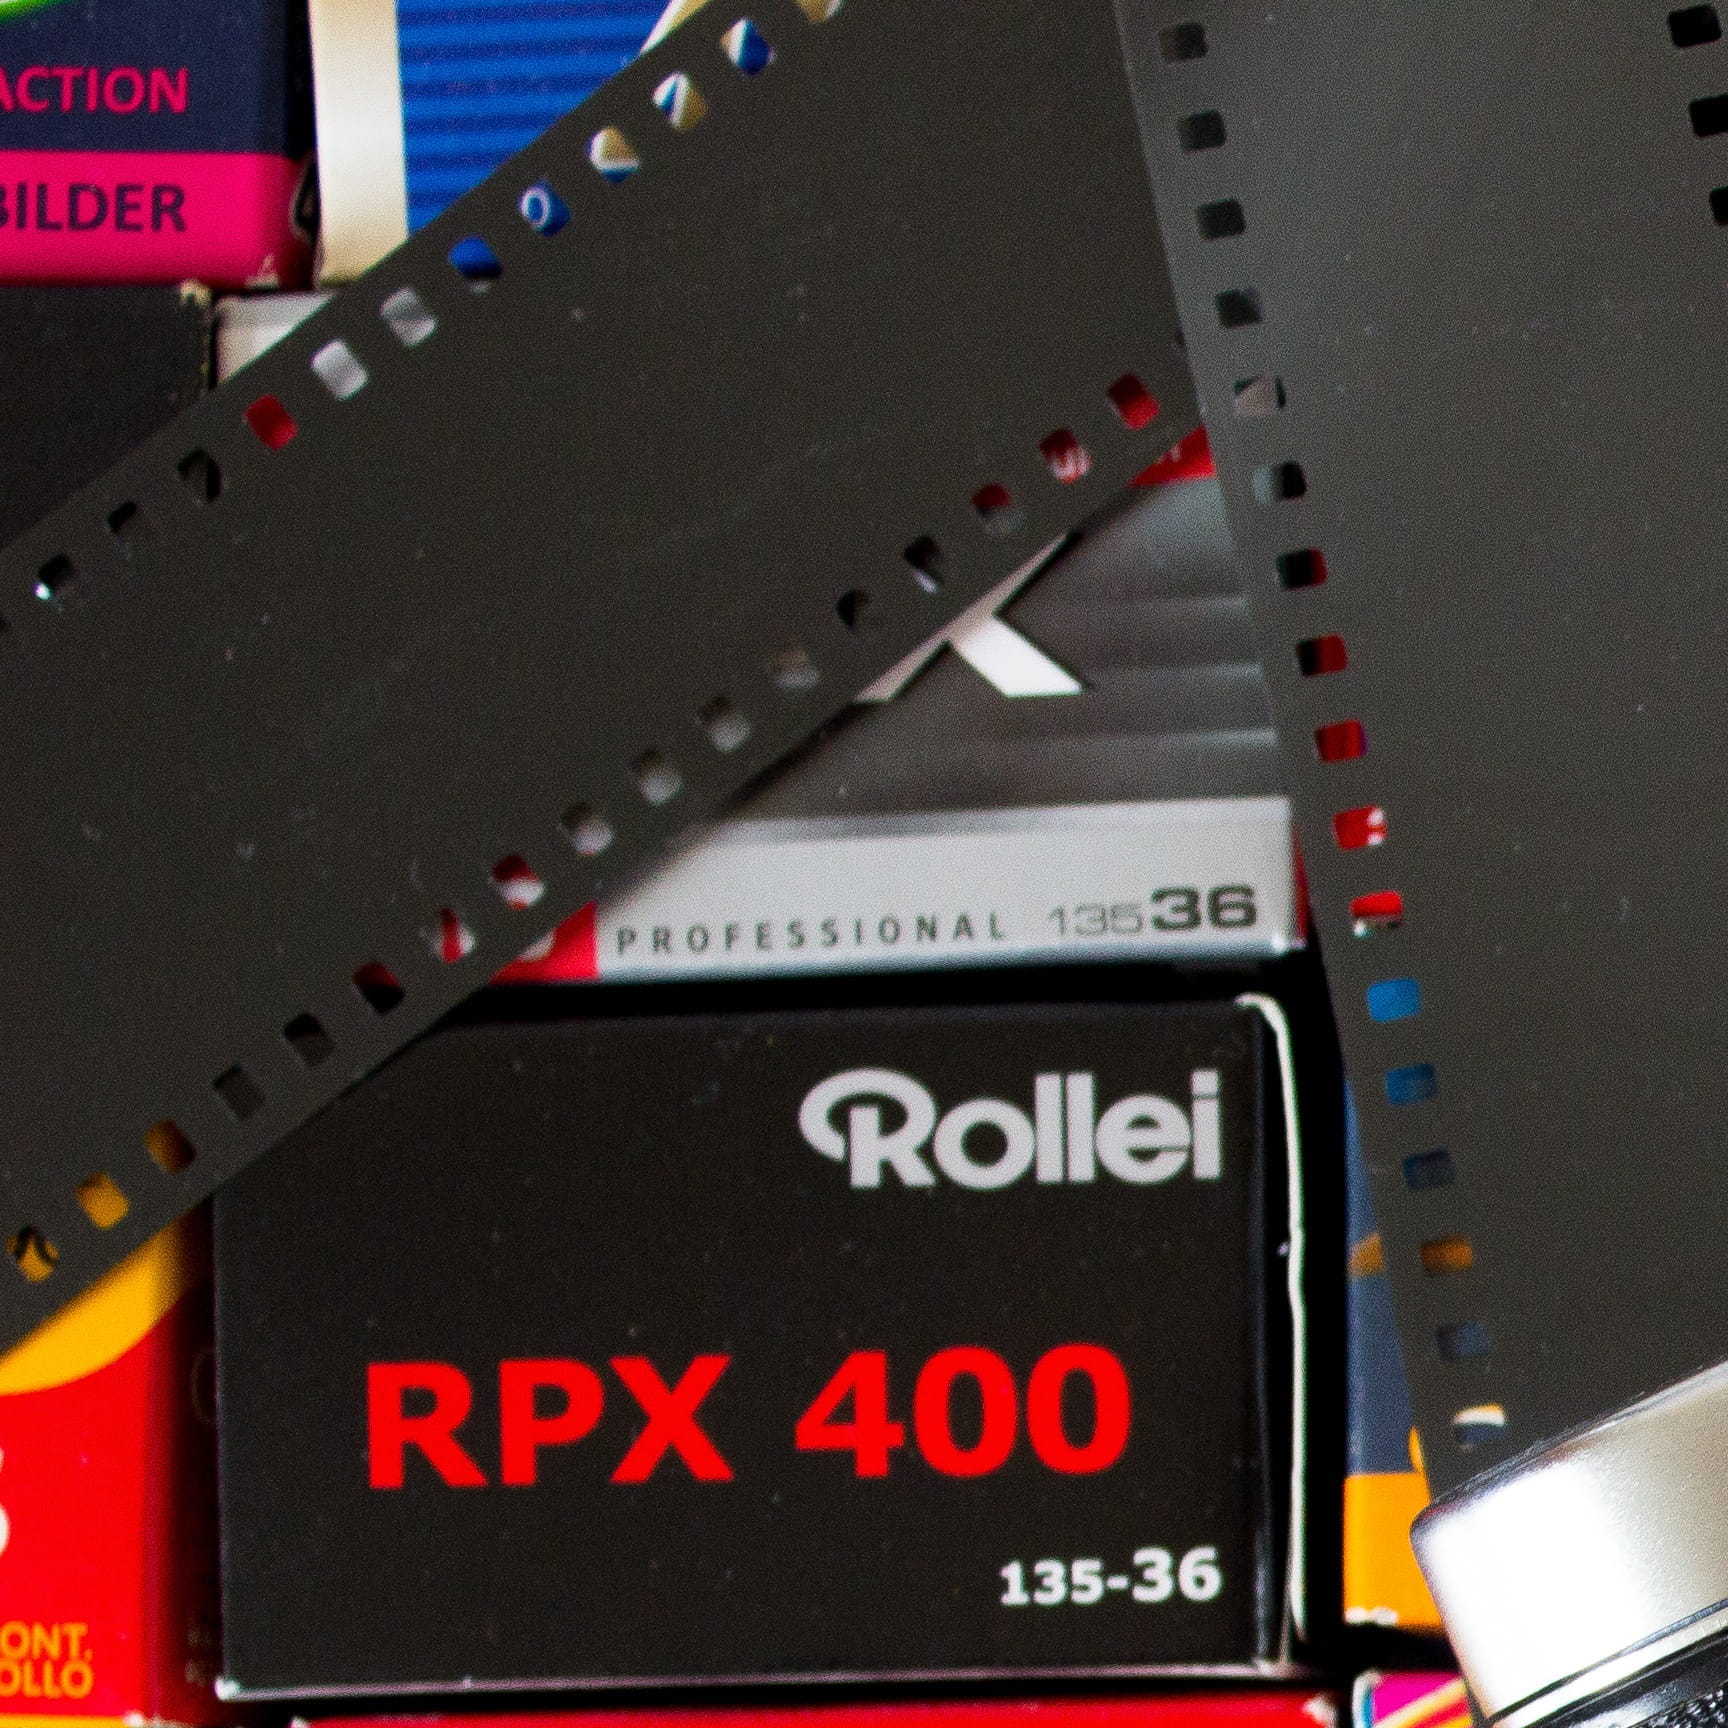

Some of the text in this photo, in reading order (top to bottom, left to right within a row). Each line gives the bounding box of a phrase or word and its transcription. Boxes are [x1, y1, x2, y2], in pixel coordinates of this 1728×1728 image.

[0, 182, 187, 232] ILDER
[616, 911, 1006, 956] PROFESSIONAL
[798, 1066, 1222, 1191] Rollei
[365, 1342, 1133, 1490] RPX 400
[998, 1547, 1223, 1608] 135-36
